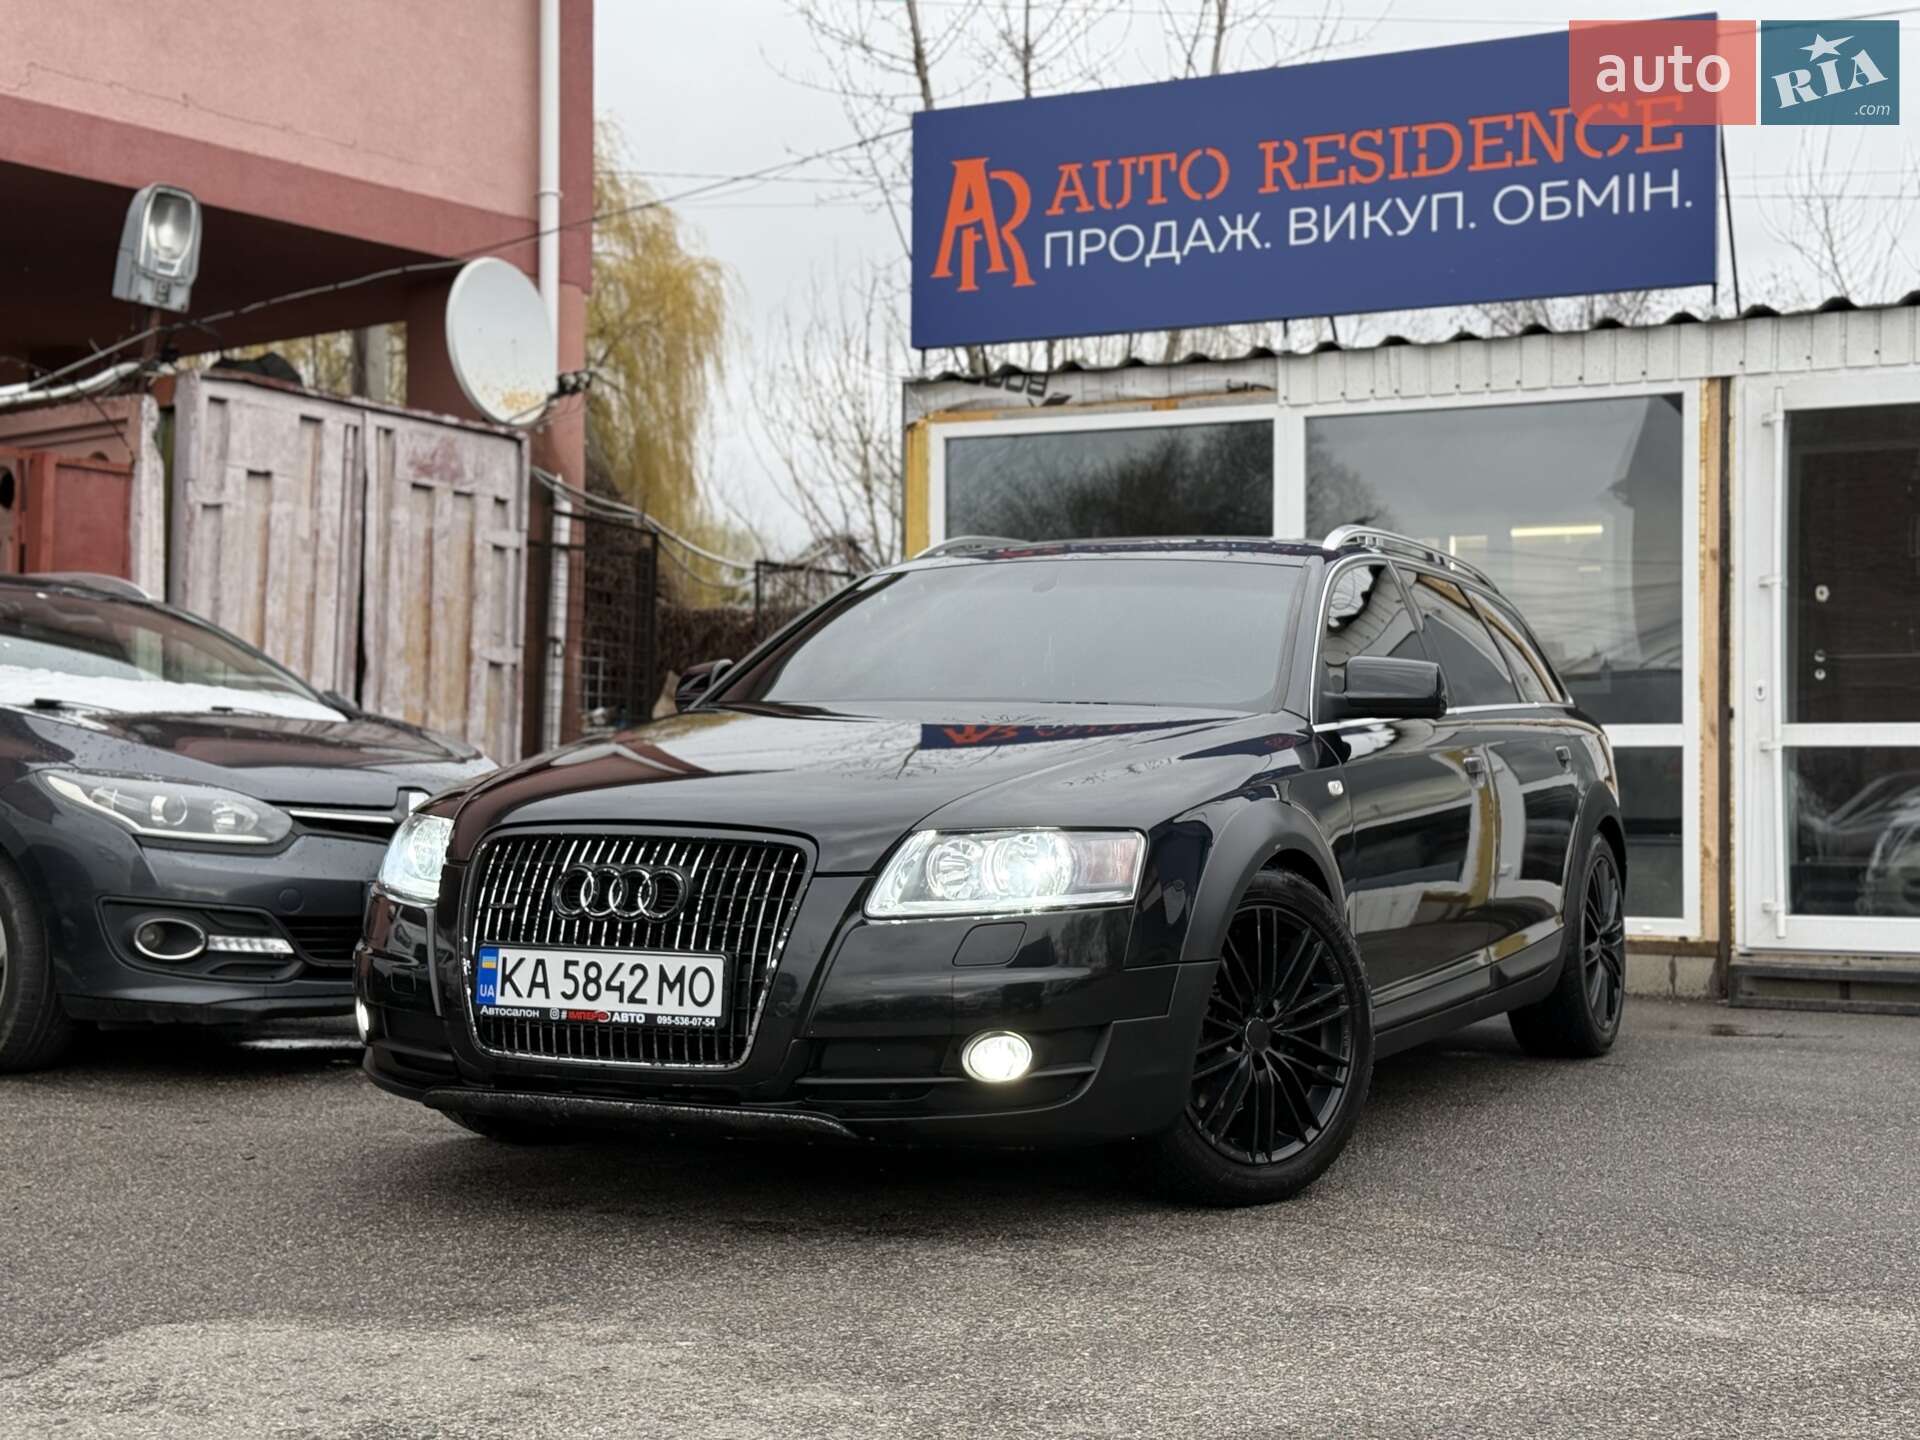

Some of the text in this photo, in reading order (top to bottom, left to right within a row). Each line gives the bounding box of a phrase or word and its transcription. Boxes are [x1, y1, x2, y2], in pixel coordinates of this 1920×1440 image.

[1045, 95, 1684, 216] AUTO RESIDENCE
[1044, 169, 1693, 269] ПРОДАЖ. ВИКУП. ОБМІН.
[480, 984, 495, 998] UA
[500, 957, 715, 1007] KA 5842 MO
[480, 1005, 540, 1018] Автосалон
